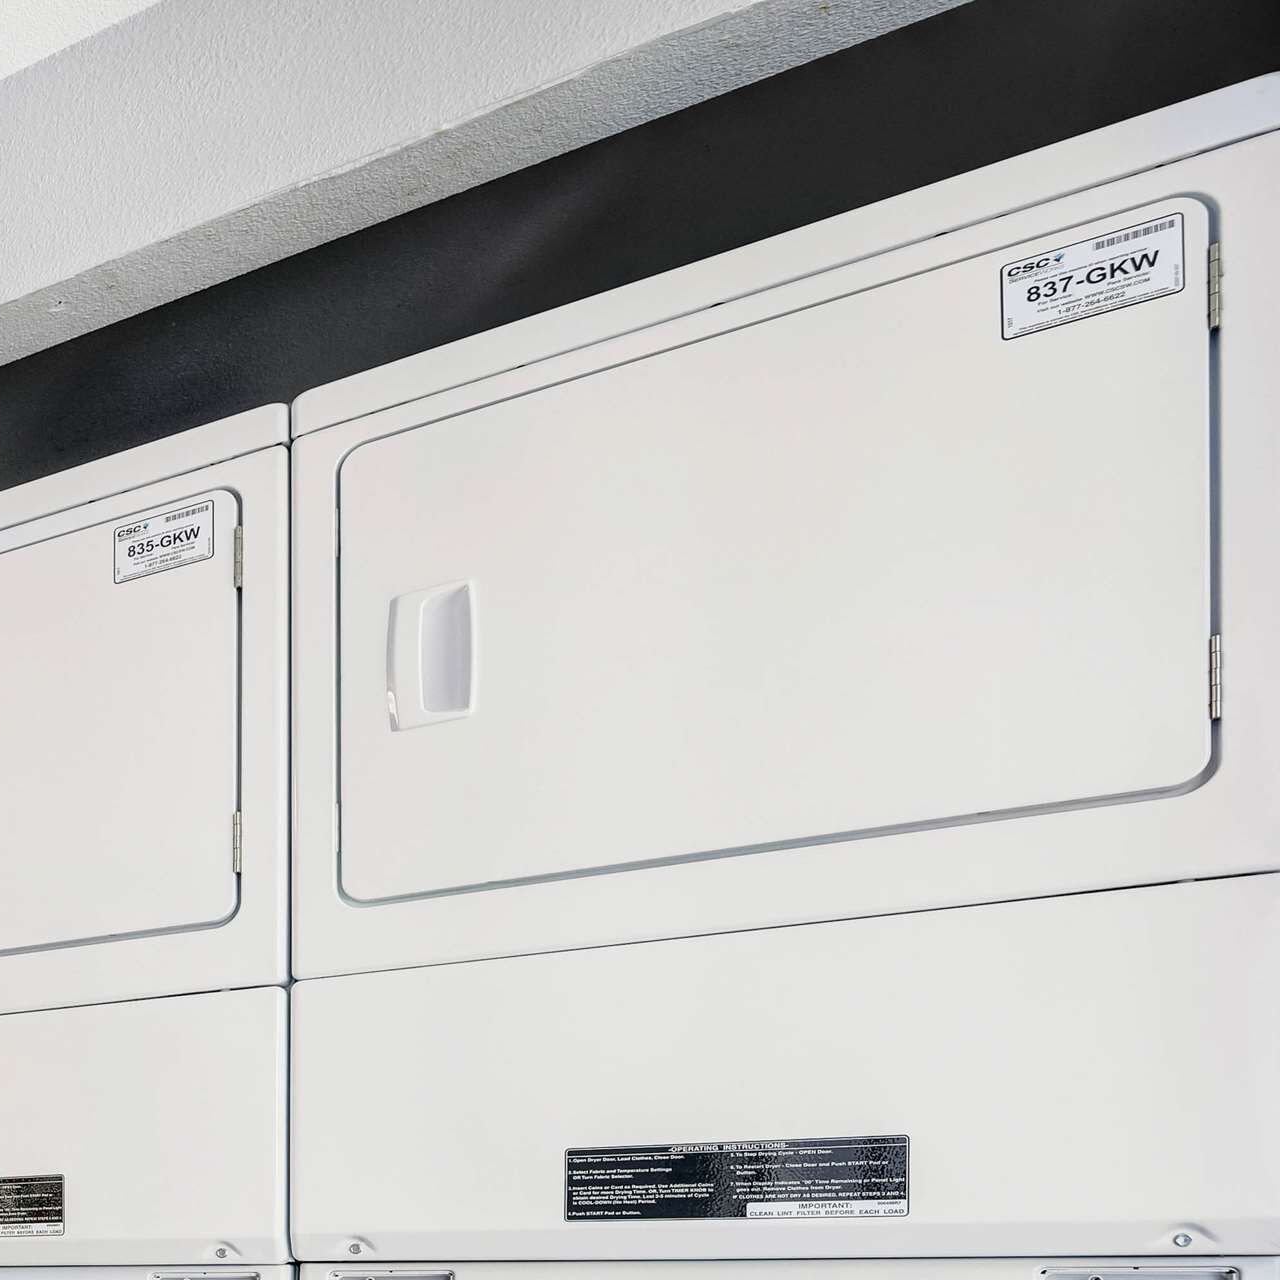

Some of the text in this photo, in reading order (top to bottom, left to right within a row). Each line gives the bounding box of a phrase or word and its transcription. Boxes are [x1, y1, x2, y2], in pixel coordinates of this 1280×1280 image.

[1008, 258, 1050, 277] CSC
[1027, 250, 1160, 302] 837-GKW
[1058, 292, 1126, 315] 1-877-264-6622
[117, 526, 141, 537] CSC
[128, 526, 200, 558] 835-GKW
